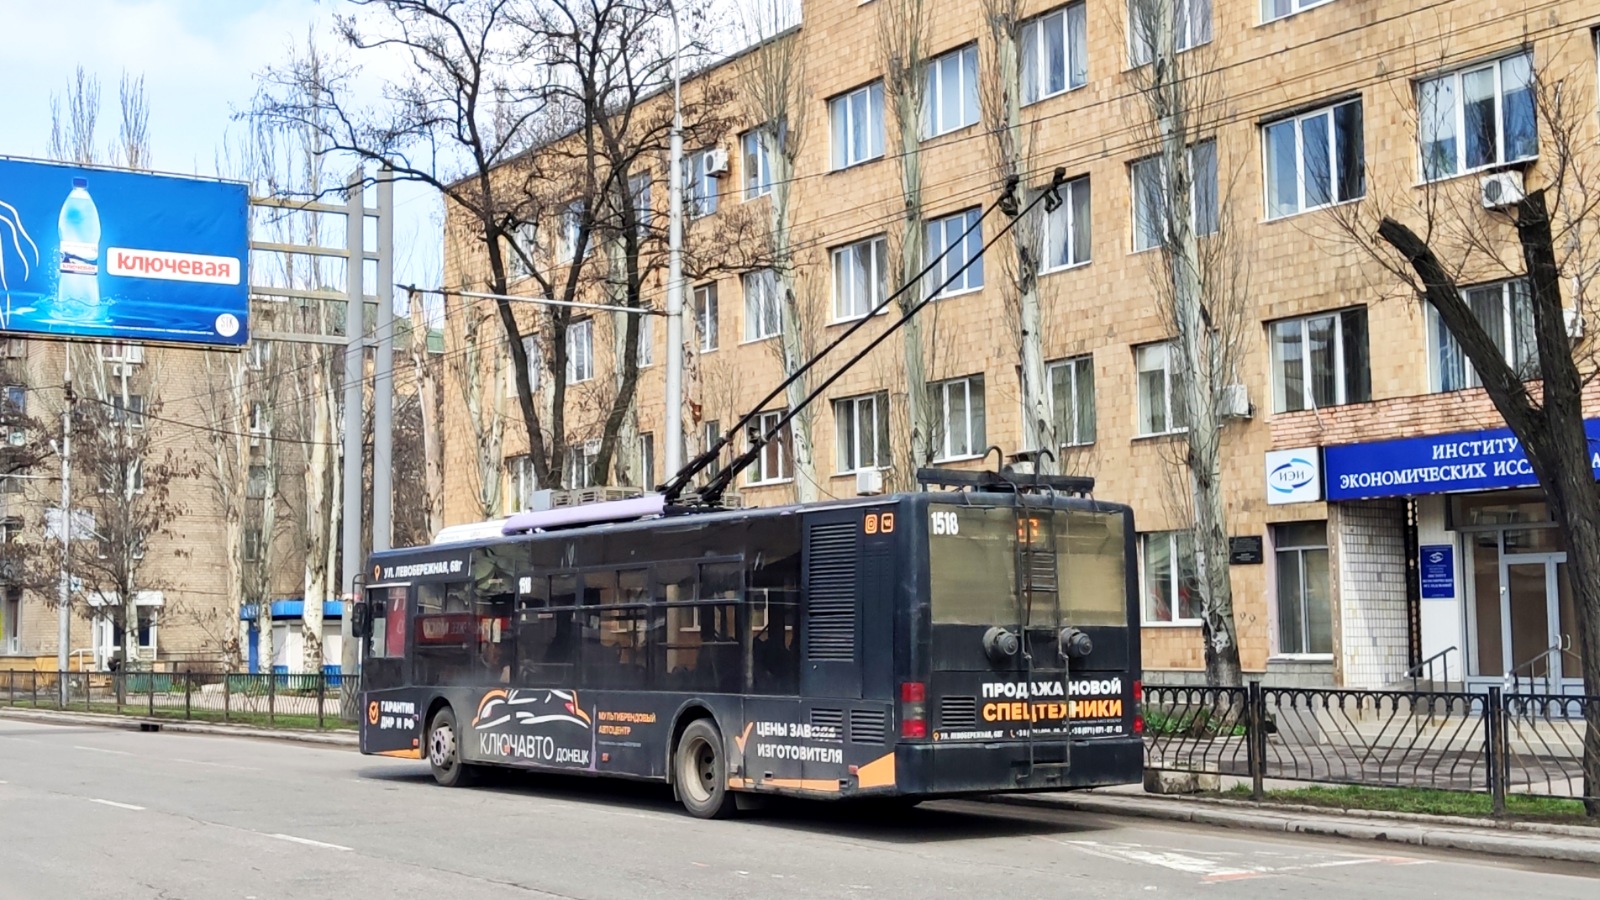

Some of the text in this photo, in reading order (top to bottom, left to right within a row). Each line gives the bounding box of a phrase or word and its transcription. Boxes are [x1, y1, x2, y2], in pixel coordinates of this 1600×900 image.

[117, 252, 231, 278] ключевая
[1431, 437, 1523, 460] ИНСТИТУ
[1279, 470, 1305, 482] ИЭИ
[1339, 462, 1487, 489] ЭКОНОМИЧЕСКИХ
[930, 511, 959, 535] 1518
[982, 677, 1121, 699] ПРОДАЖА НОВОЙ
[380, 700, 415, 714] ГАРАНТИЯ
[983, 699, 1122, 722] СПЕЦТЕХНИКИ
[380, 715, 395, 730] ДНР
[403, 717, 415, 730] РФ
[756, 721, 787, 737] ЦЕНЫ
[479, 733, 590, 763] КЛЮЧАВТО ДОНЕЦК
[757, 743, 843, 764] ИЗГОТОВИТЕЛЯ
